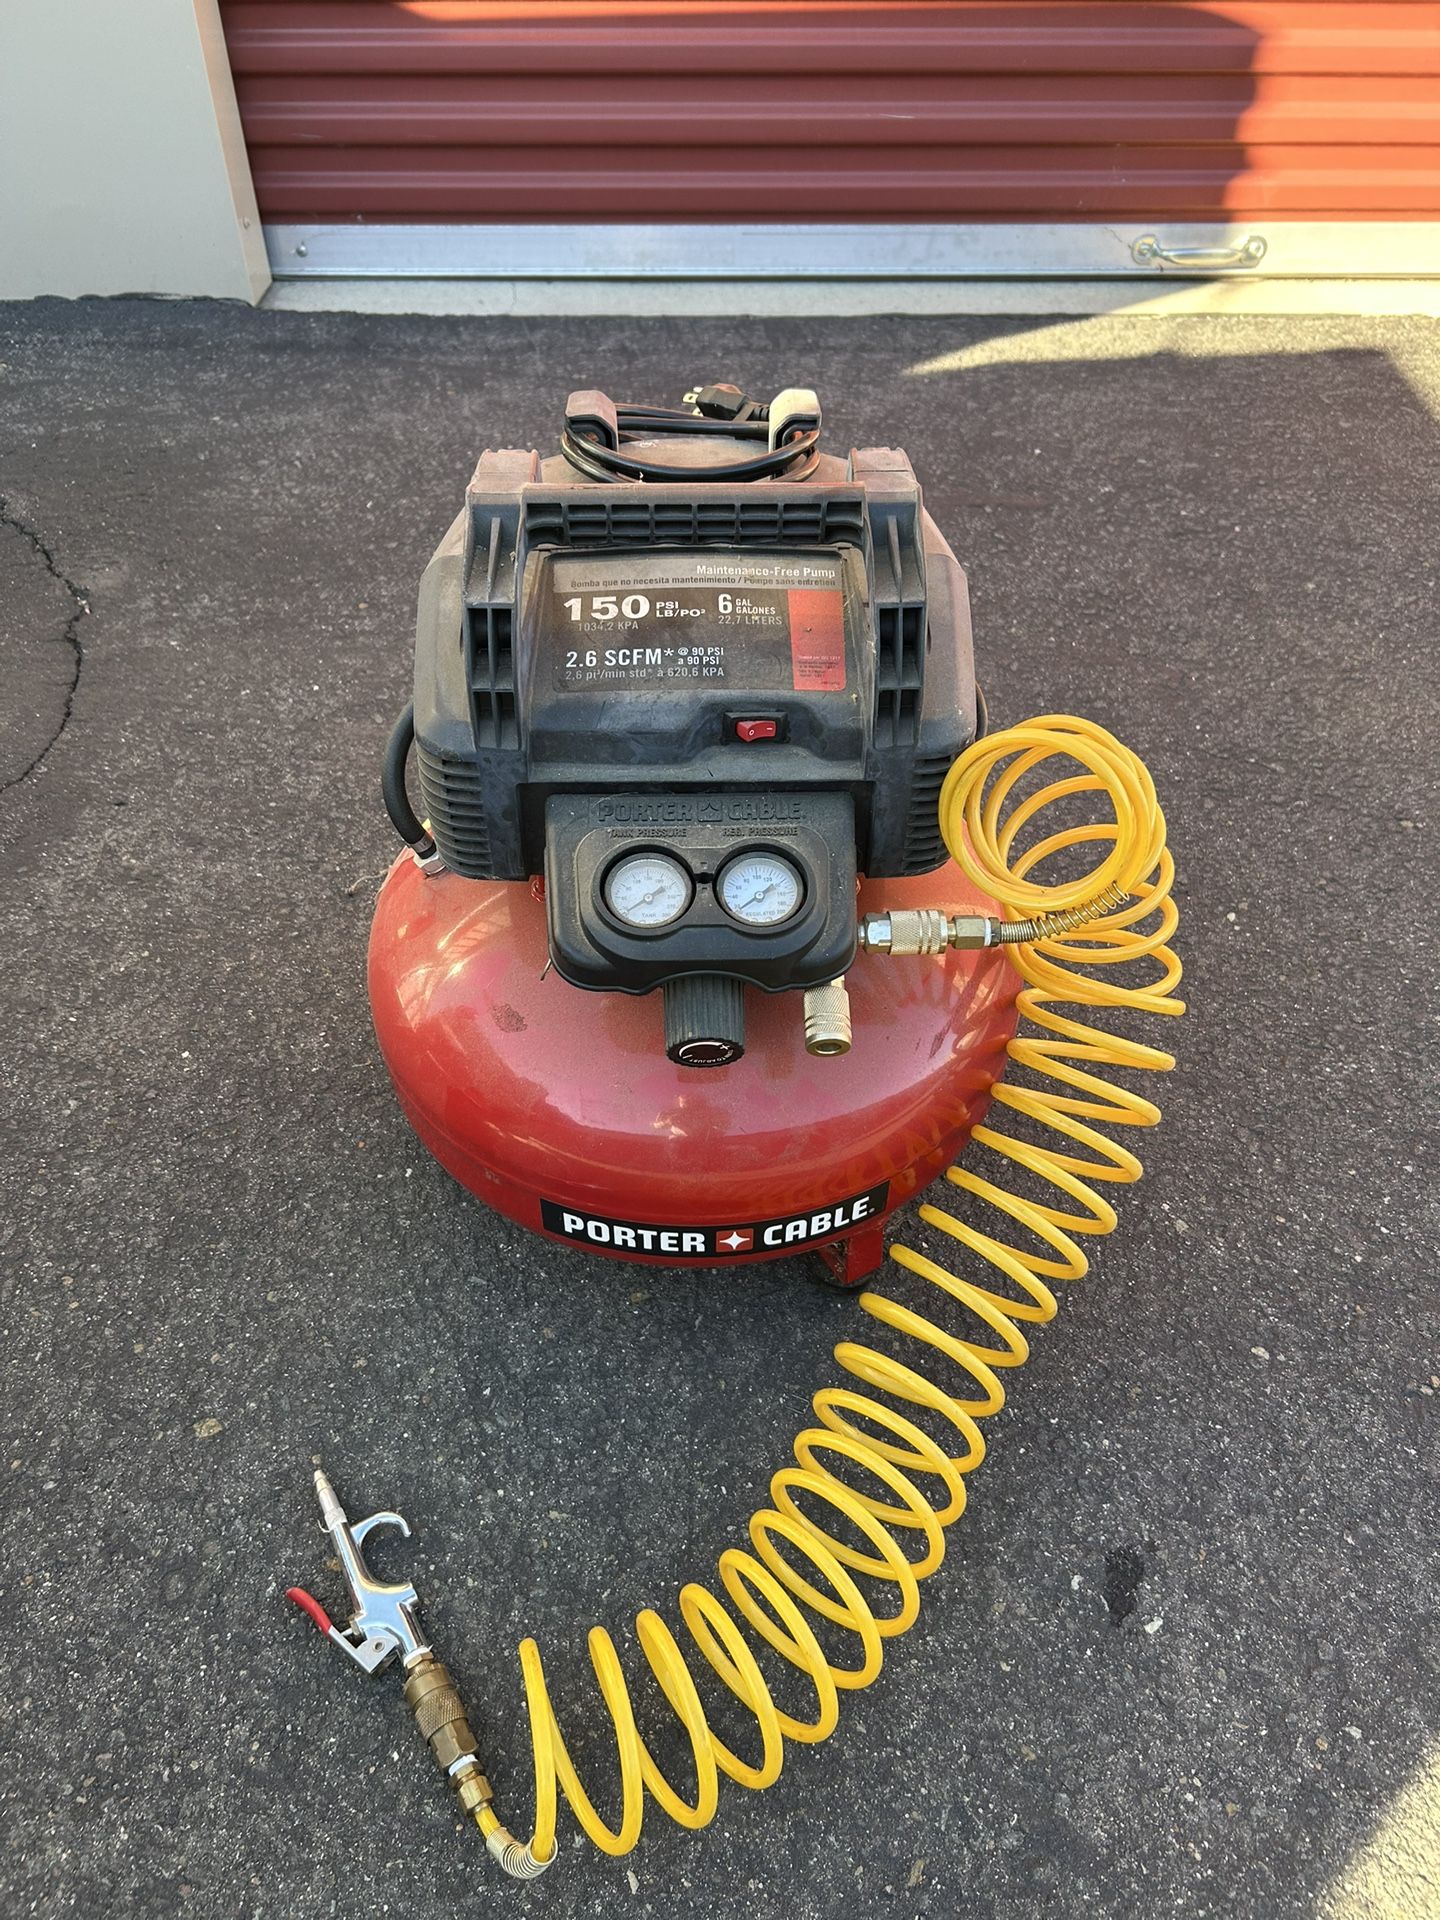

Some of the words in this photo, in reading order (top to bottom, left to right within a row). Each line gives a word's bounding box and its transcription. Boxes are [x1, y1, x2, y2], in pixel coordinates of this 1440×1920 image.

[804, 567, 836, 579] Pump
[570, 580, 600, 588] Bomba
[602, 580, 618, 588] que
[634, 576, 670, 585] necesita
[672, 574, 736, 584] mantenimiento
[744, 577, 773, 586] Pompe
[797, 578, 836, 586] entretien
[563, 594, 650, 621] 150
[656, 601, 679, 610] PSI
[718, 594, 732, 614] 6
[736, 598, 753, 607] GAL
[736, 606, 776, 615] GALONES
[618, 620, 639, 631] KPA
[745, 616, 782, 626] LITERS
[678, 646, 688, 656] @
[692, 646, 704, 656] 90
[708, 646, 724, 656] PSI
[566, 650, 598, 668] 2.6
[687, 656, 700, 664] 90
[702, 656, 720, 664] PSI
[702, 666, 724, 676] KPA
[598, 802, 692, 822] PORTER
[609, 828, 634, 838] TANK
[636, 828, 688, 838] PRESSURE
[748, 826, 798, 836] PRESSURE
[562, 1212, 706, 1252] PORTER
